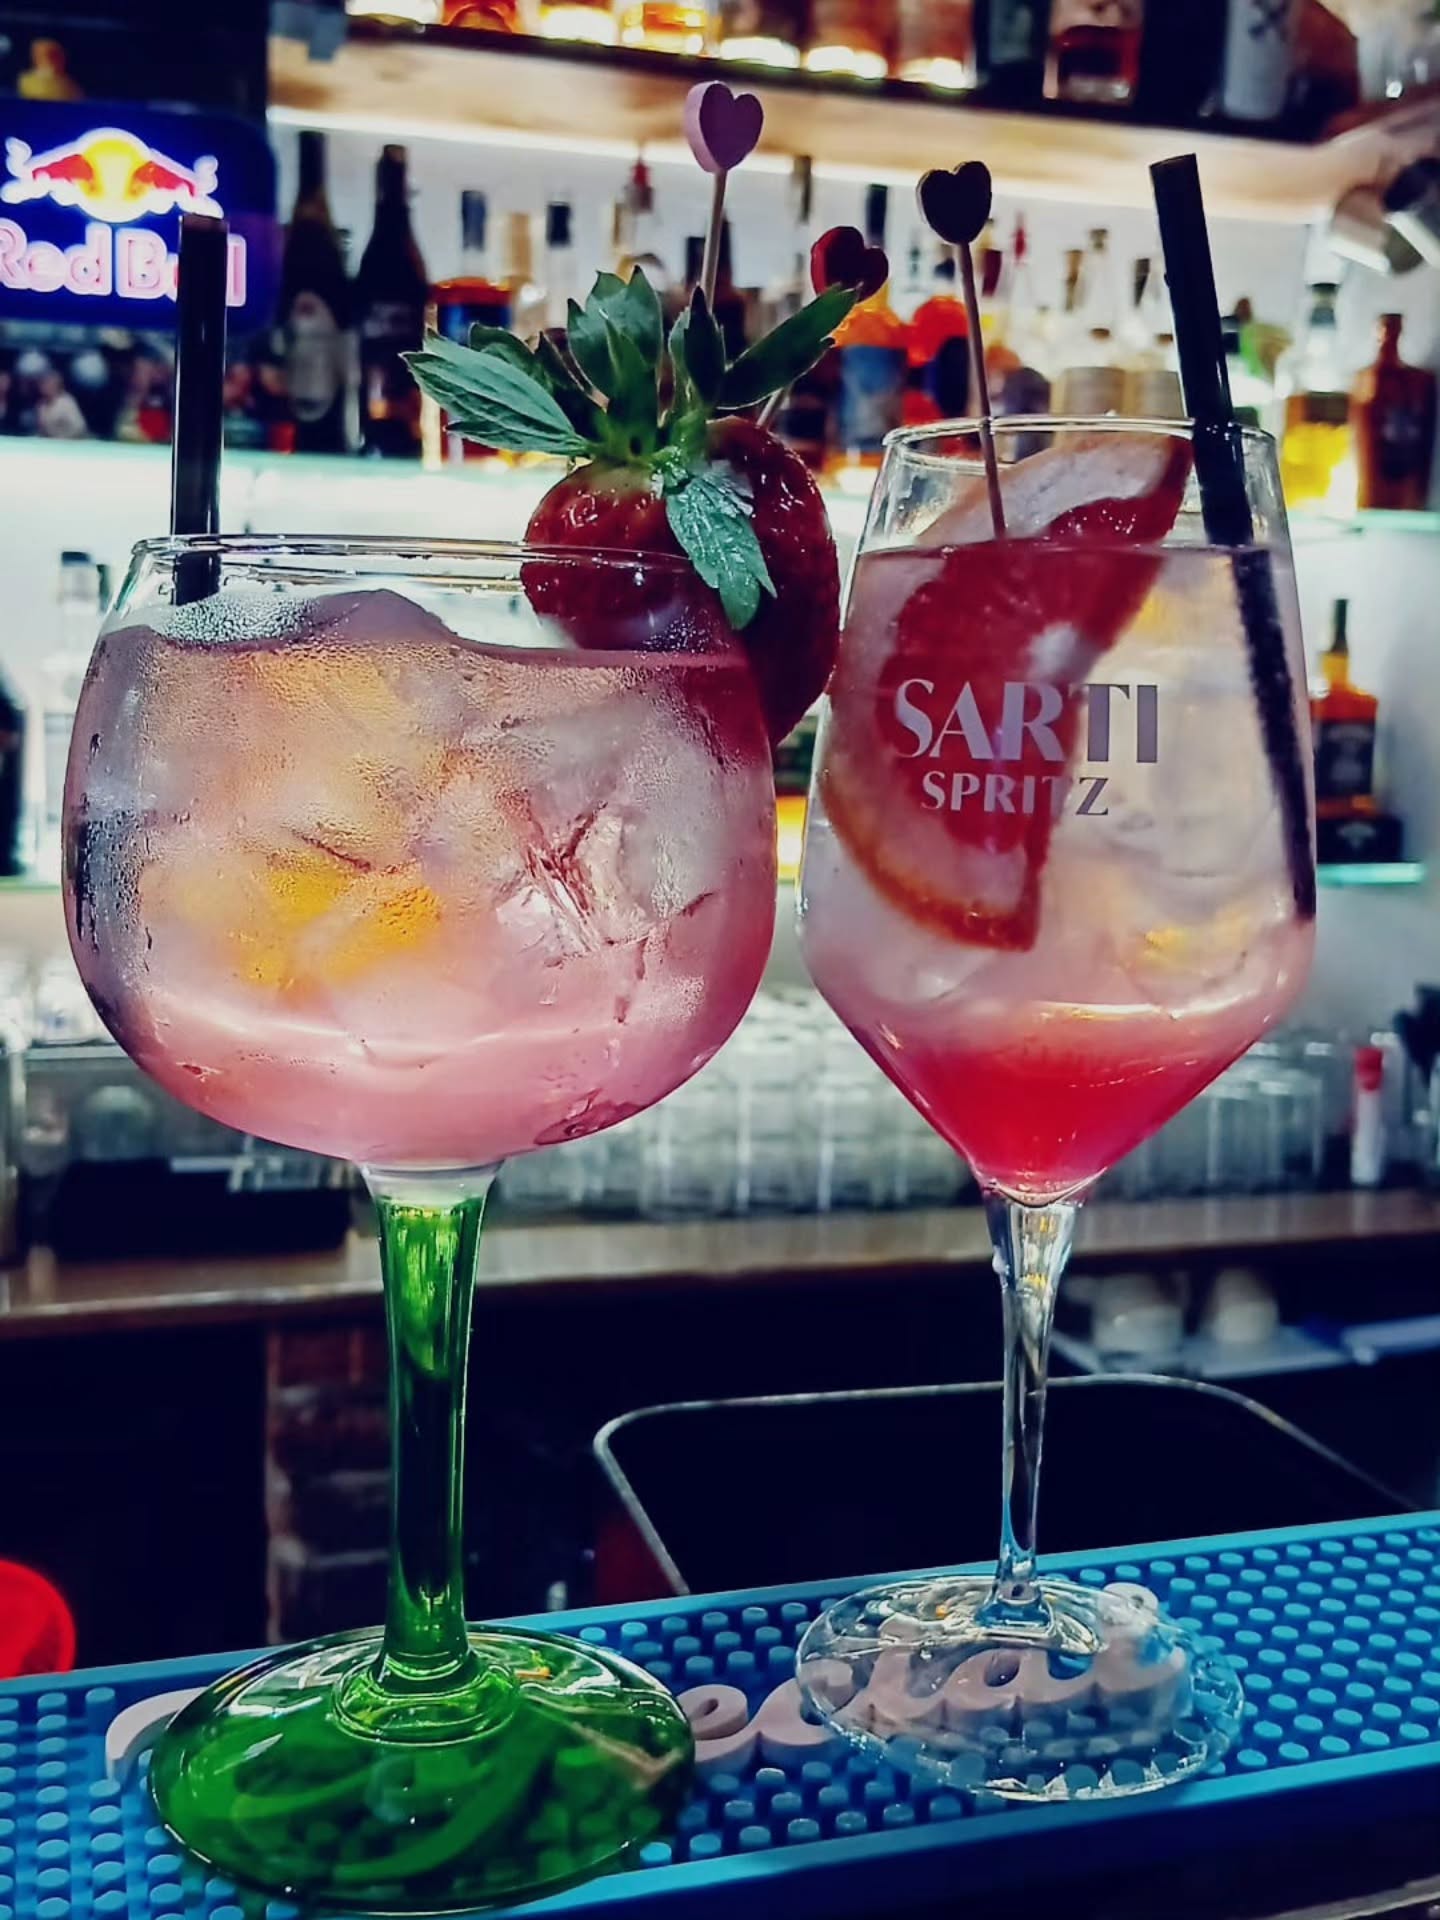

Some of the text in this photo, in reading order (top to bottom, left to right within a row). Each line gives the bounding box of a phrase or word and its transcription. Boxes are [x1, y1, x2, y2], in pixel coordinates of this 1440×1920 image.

[115, 227, 247, 307] Bl
[894, 678, 1159, 763] SARTI
[920, 770, 1109, 817] SPRITZ
